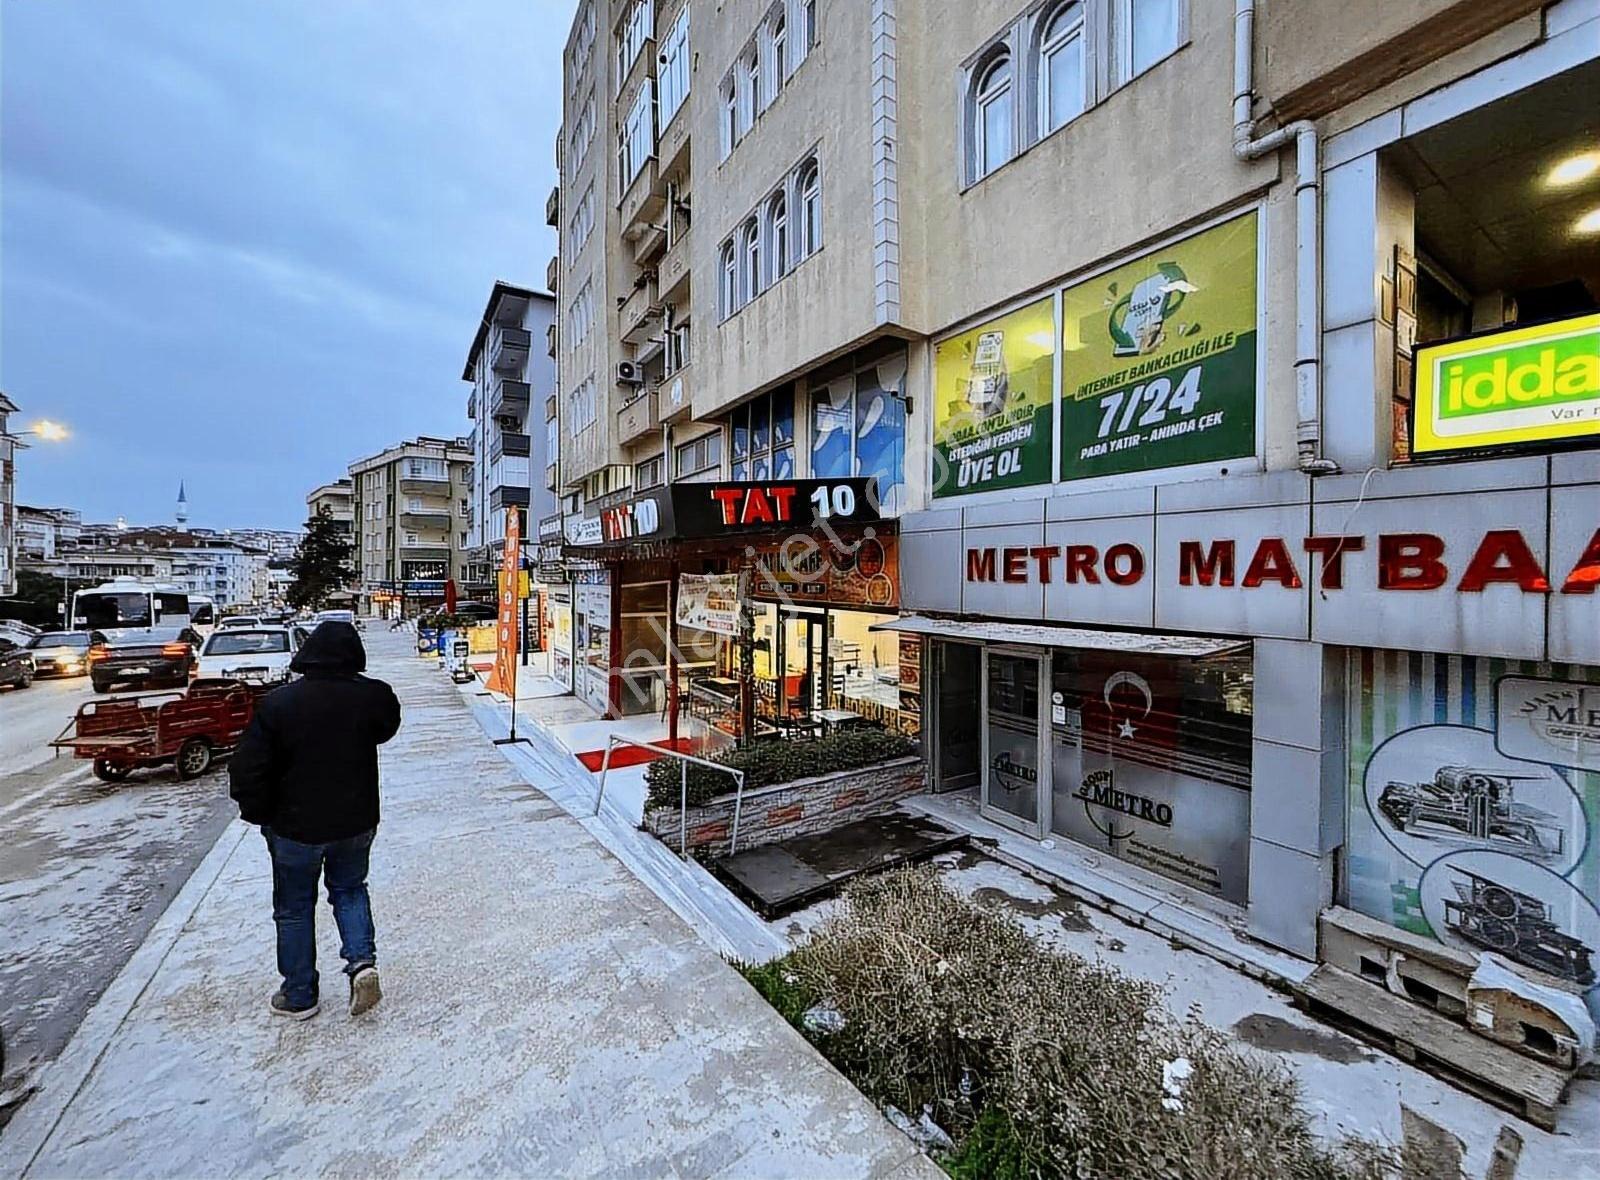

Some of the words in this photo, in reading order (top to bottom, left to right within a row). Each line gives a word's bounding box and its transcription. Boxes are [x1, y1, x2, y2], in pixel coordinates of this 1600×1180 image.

[1448, 349, 1600, 411] idda
[1097, 366, 1202, 438] 7/24
[1551, 408, 1584, 420] Var
[991, 423, 1033, 448] YERDEN
[1080, 443, 1107, 460] PARA
[1109, 434, 1141, 453] YATIR
[1149, 418, 1196, 442] ANINDA
[1198, 411, 1225, 432] ÇEK
[957, 455, 995, 488] ÜYE
[997, 448, 1022, 477] OL
[711, 486, 796, 525] TAT
[810, 484, 856, 518] 10
[966, 543, 1146, 586] METRO
[1093, 784, 1173, 825] METRO
